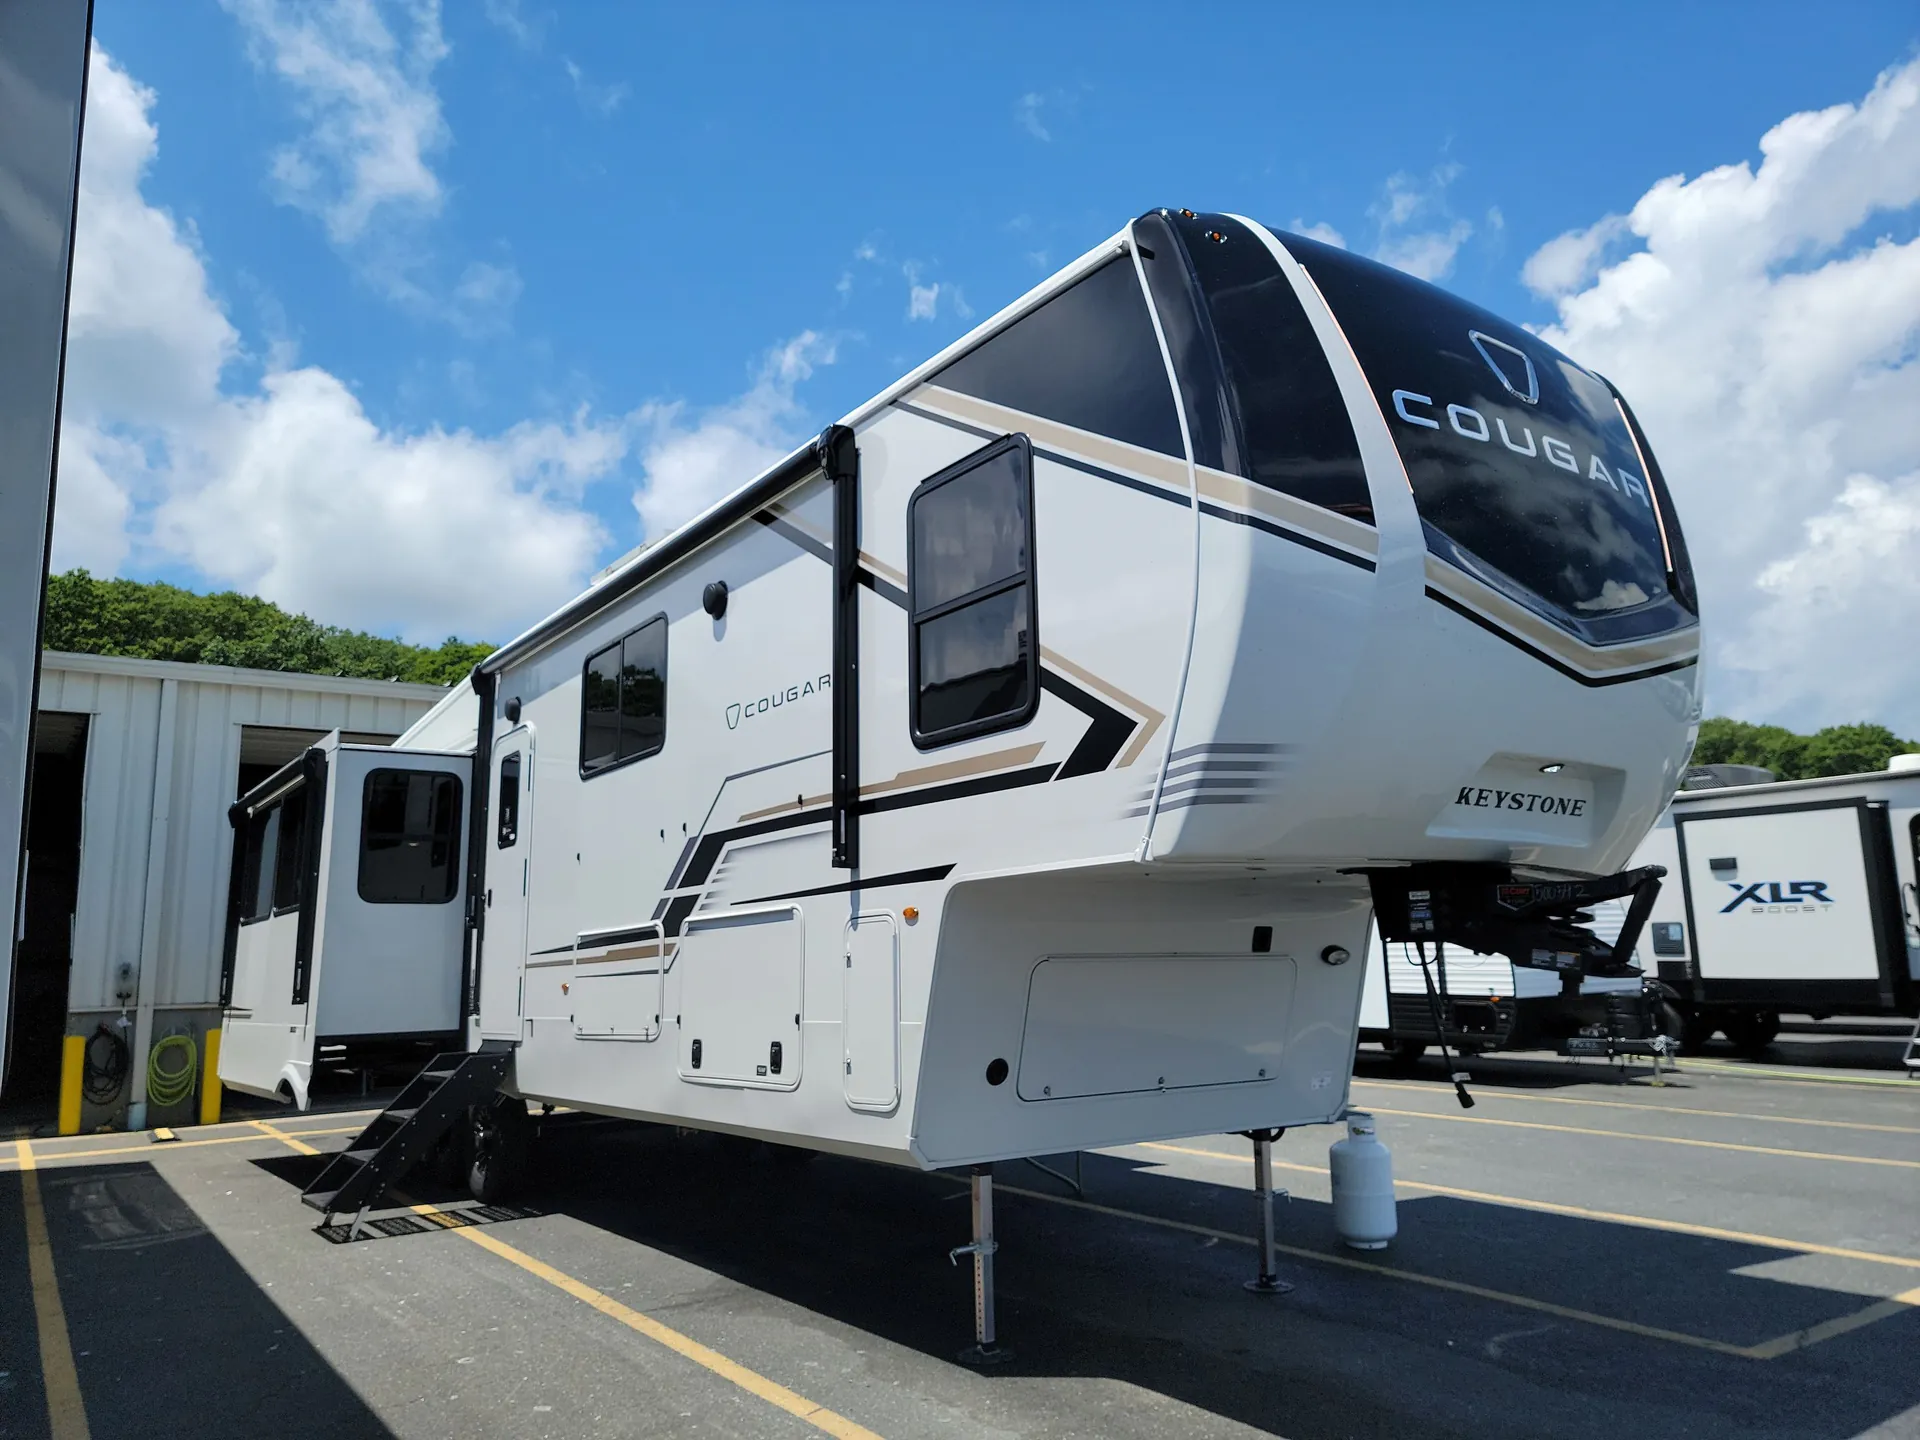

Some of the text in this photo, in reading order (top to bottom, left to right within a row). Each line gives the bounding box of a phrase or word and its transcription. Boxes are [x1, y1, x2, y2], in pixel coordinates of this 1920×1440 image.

[1392, 389, 1651, 508] COUGAR
[744, 673, 832, 718] COUGAR
[1455, 786, 1587, 817] KEYSTONE
[1718, 881, 1834, 914] XLR
[1751, 904, 1833, 914] BOOST
